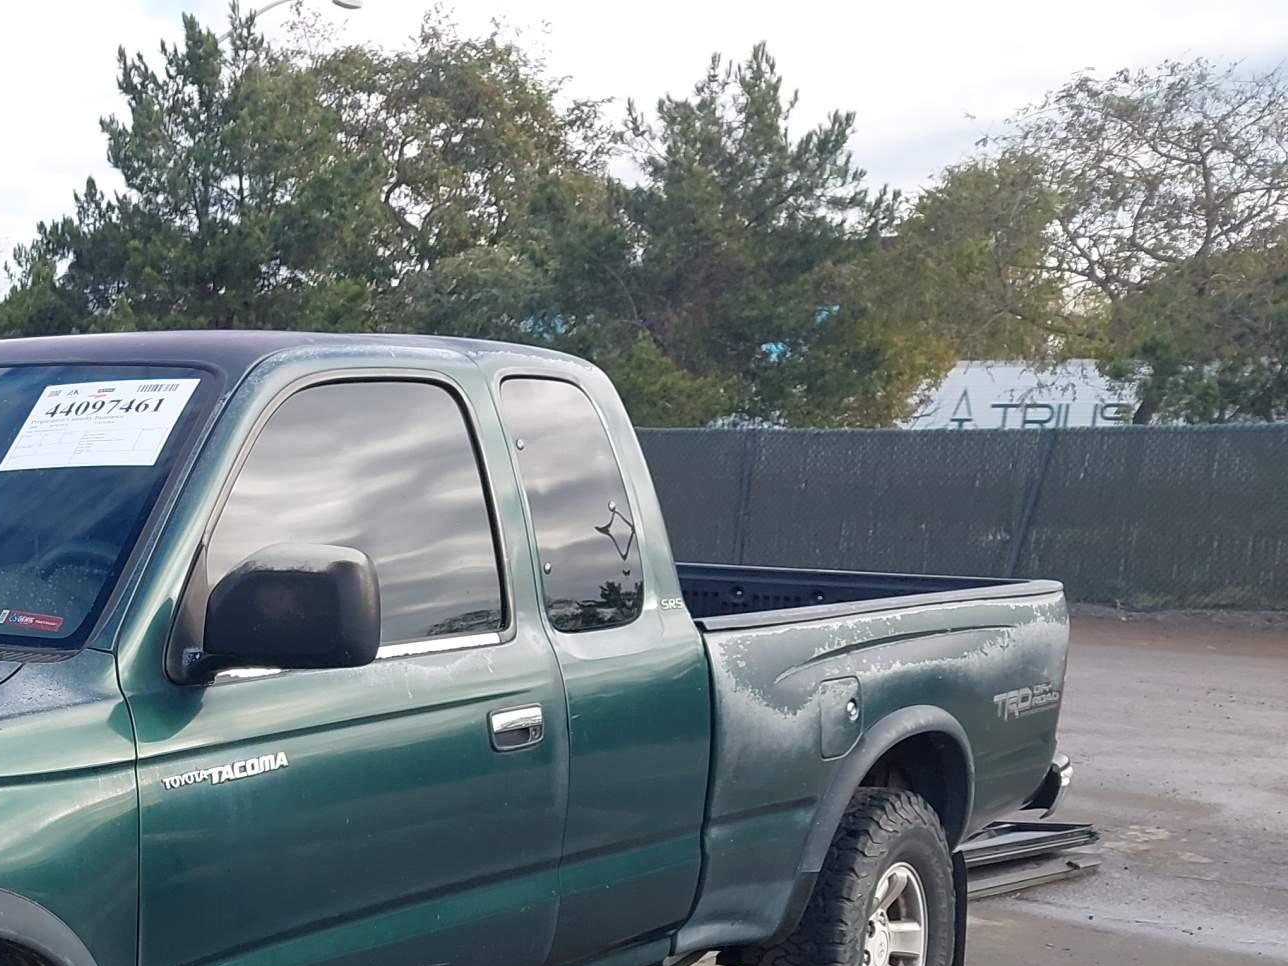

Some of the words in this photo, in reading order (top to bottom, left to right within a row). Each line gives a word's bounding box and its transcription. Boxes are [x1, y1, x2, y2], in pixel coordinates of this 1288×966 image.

[45, 397, 166, 418] 44097461
[162, 769, 209, 790] TOYOTA
[208, 752, 289, 784] TACOMA
